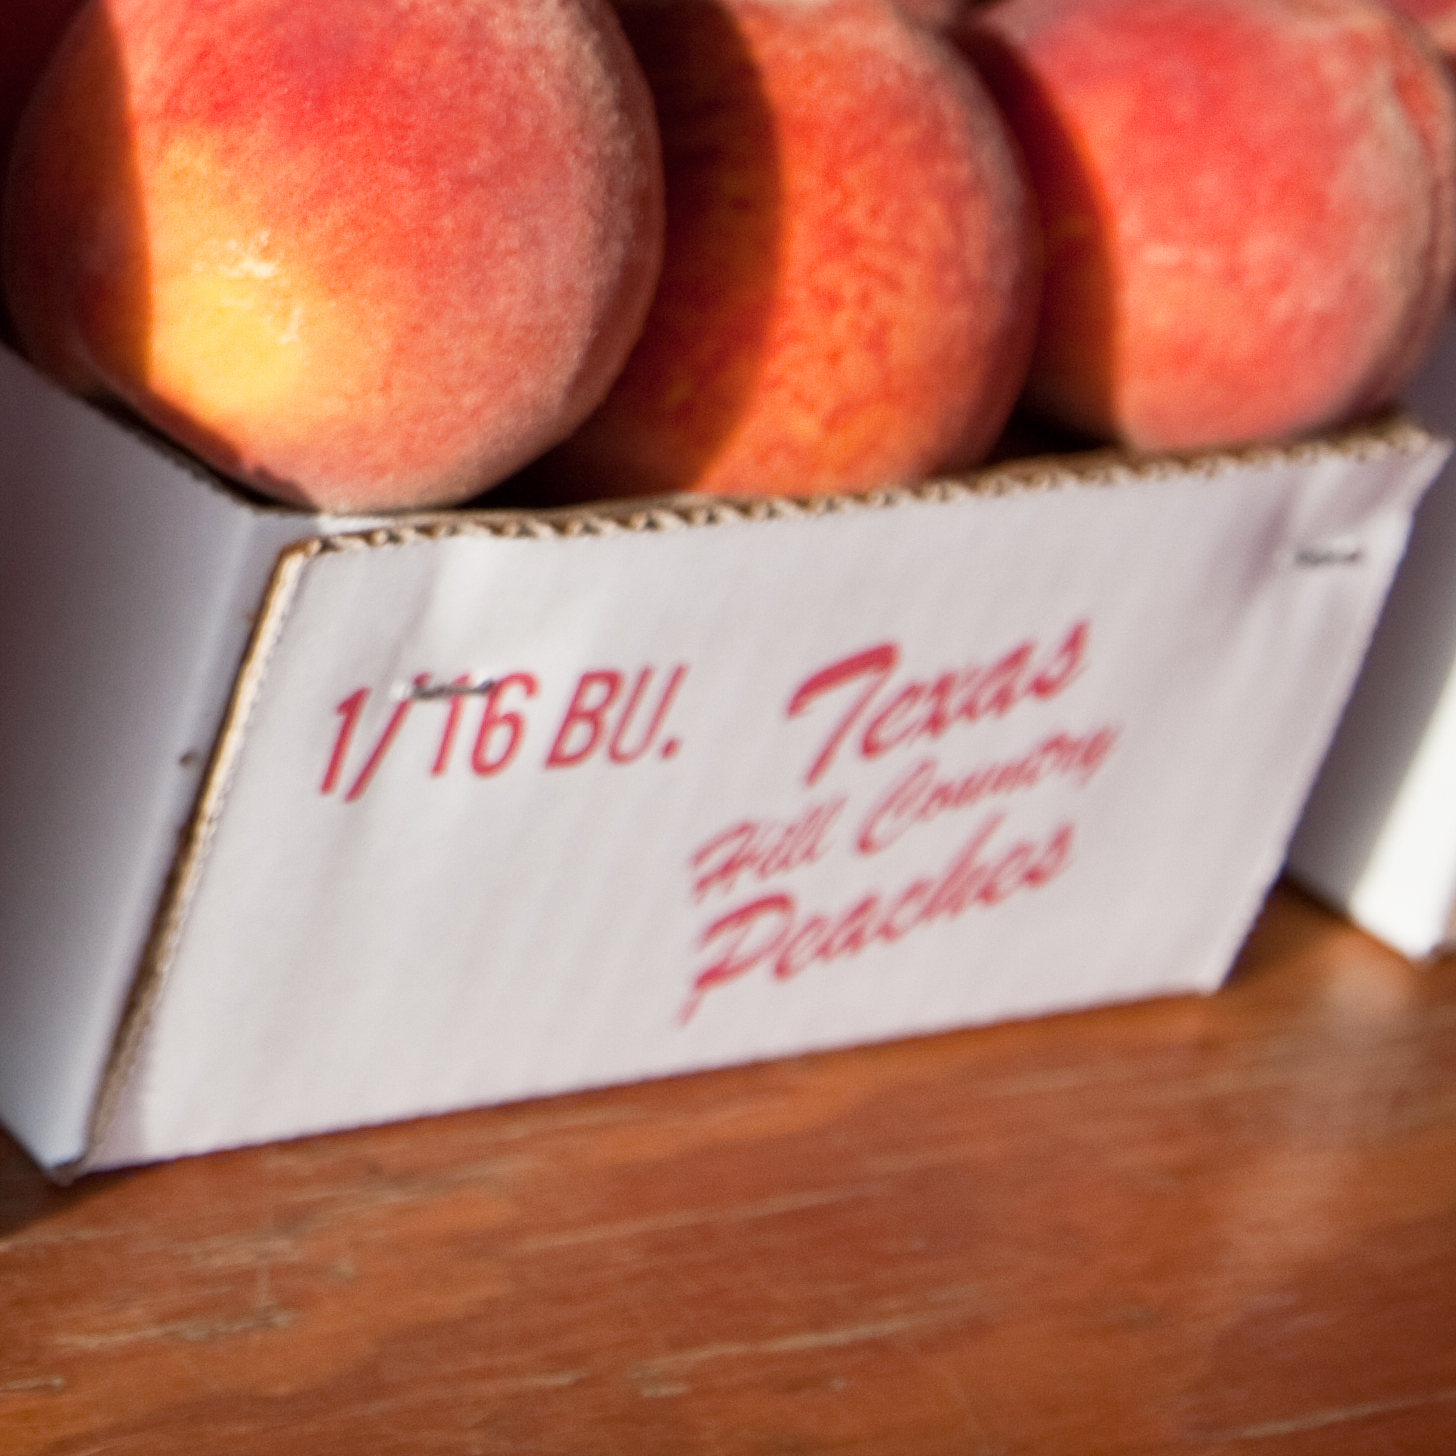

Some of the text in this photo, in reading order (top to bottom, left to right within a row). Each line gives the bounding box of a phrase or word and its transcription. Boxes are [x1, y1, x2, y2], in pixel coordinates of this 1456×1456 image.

[543, 664, 688, 770] BU.
[785, 620, 1090, 787] Texas
[690, 721, 1124, 905] Hill Country
[679, 814, 1076, 1026] Peaches
